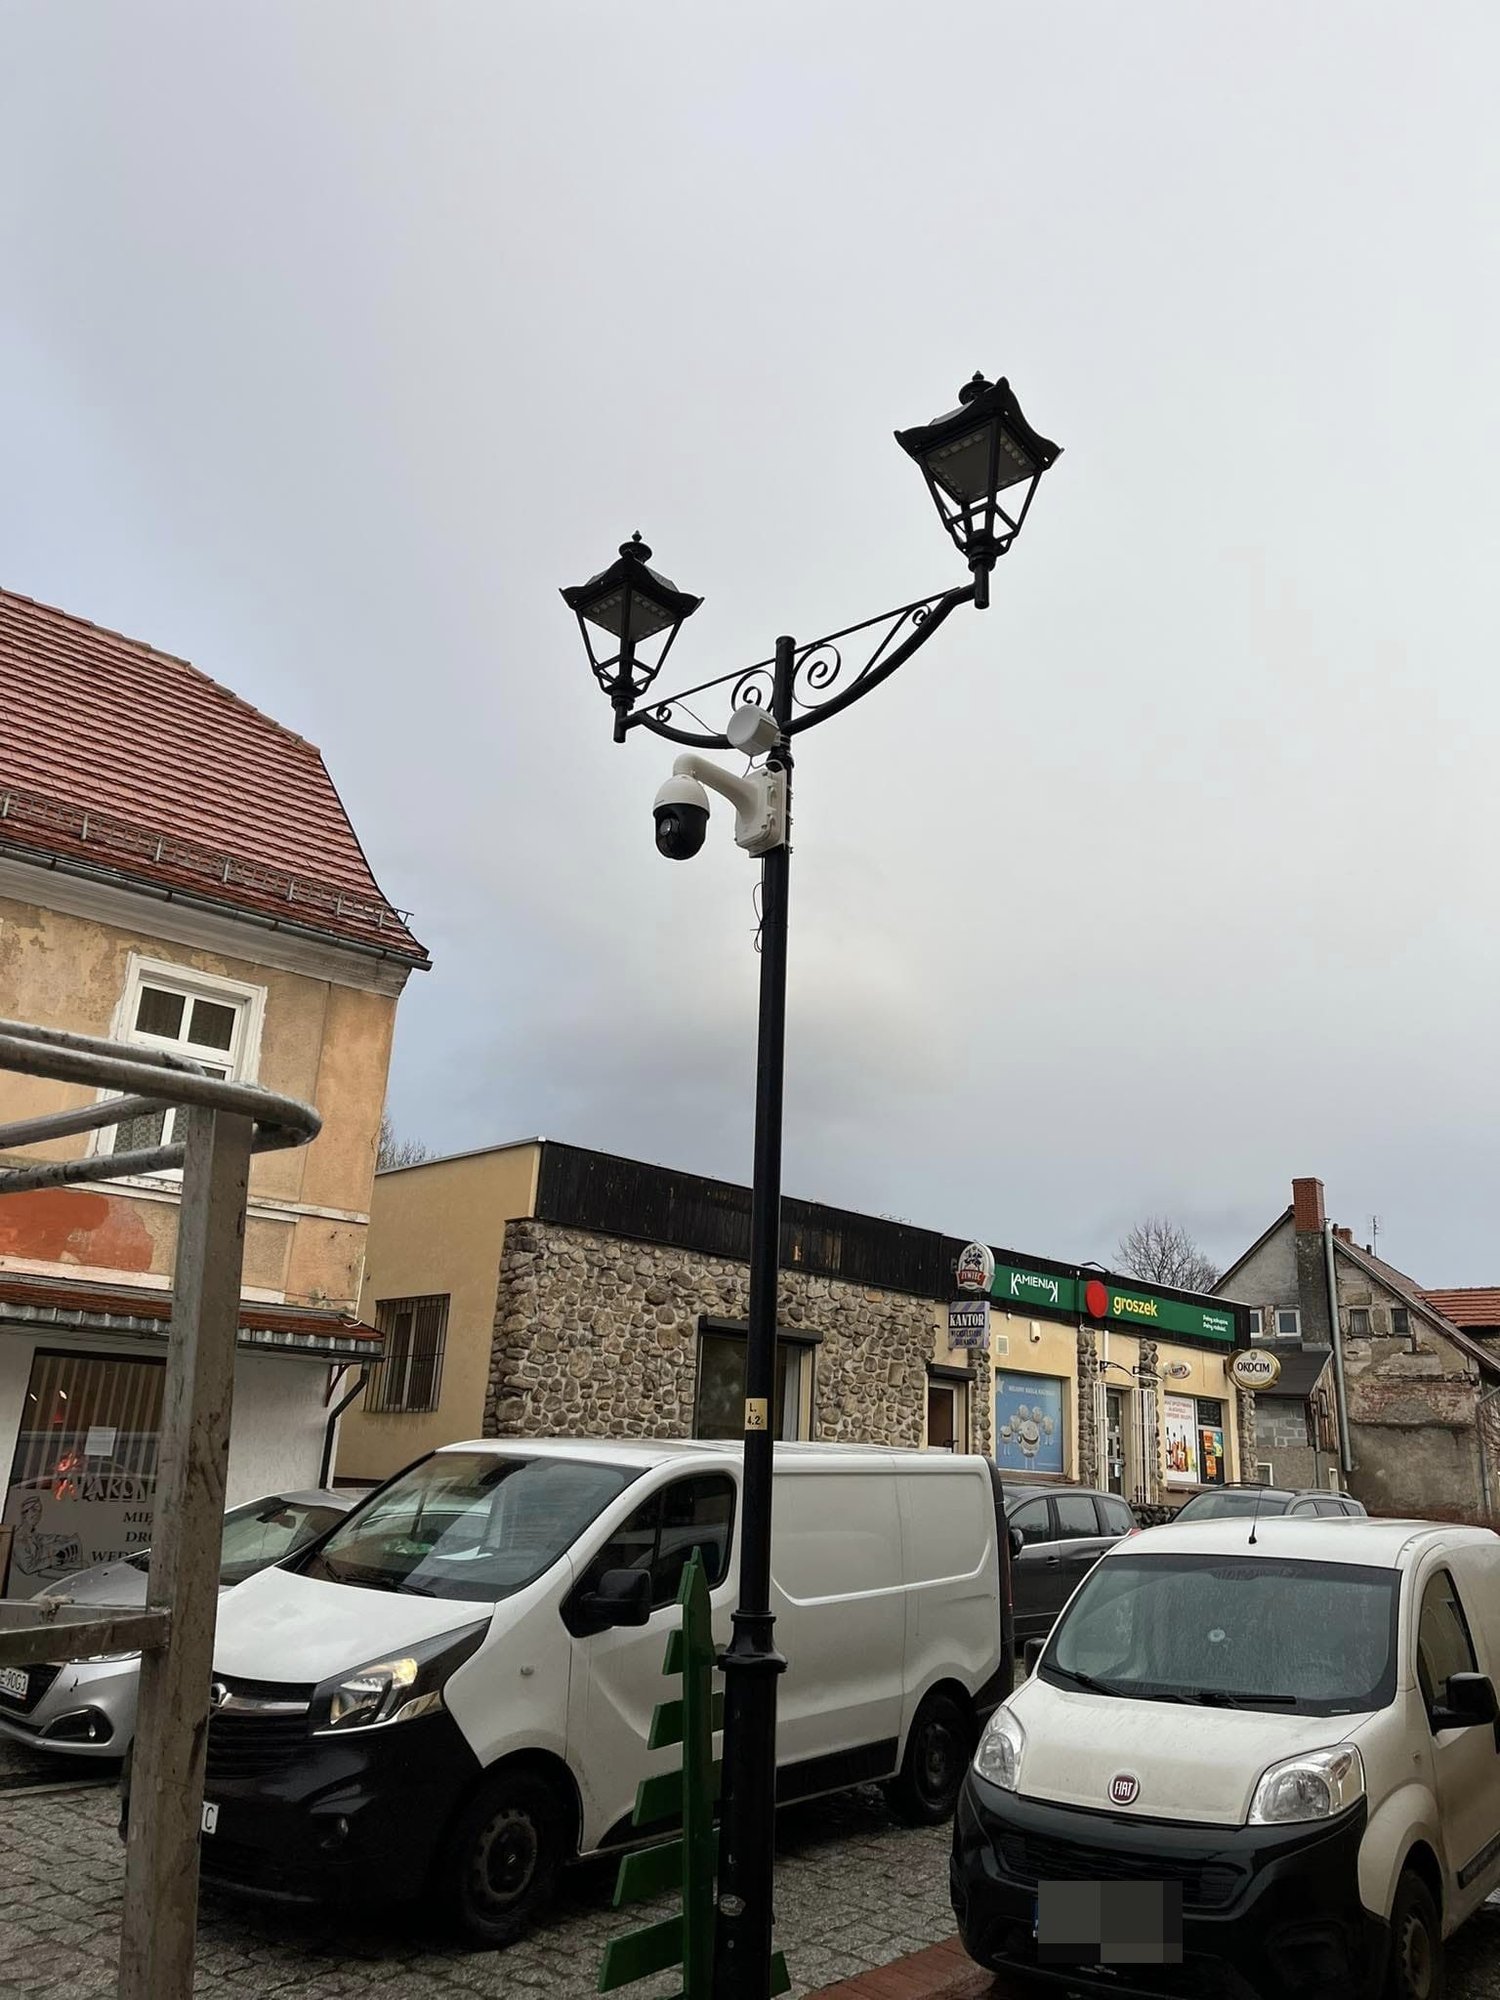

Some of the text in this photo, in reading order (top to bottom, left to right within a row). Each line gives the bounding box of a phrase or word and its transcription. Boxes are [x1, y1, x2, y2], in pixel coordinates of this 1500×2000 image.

[1010, 1272, 1059, 1303] KAMIENIAK
[1113, 1296, 1158, 1317] groszek
[949, 1312, 985, 1327] KANTOR
[1237, 1362, 1270, 1373] OKOCIM
[1114, 1780, 1134, 1797] FIAT
